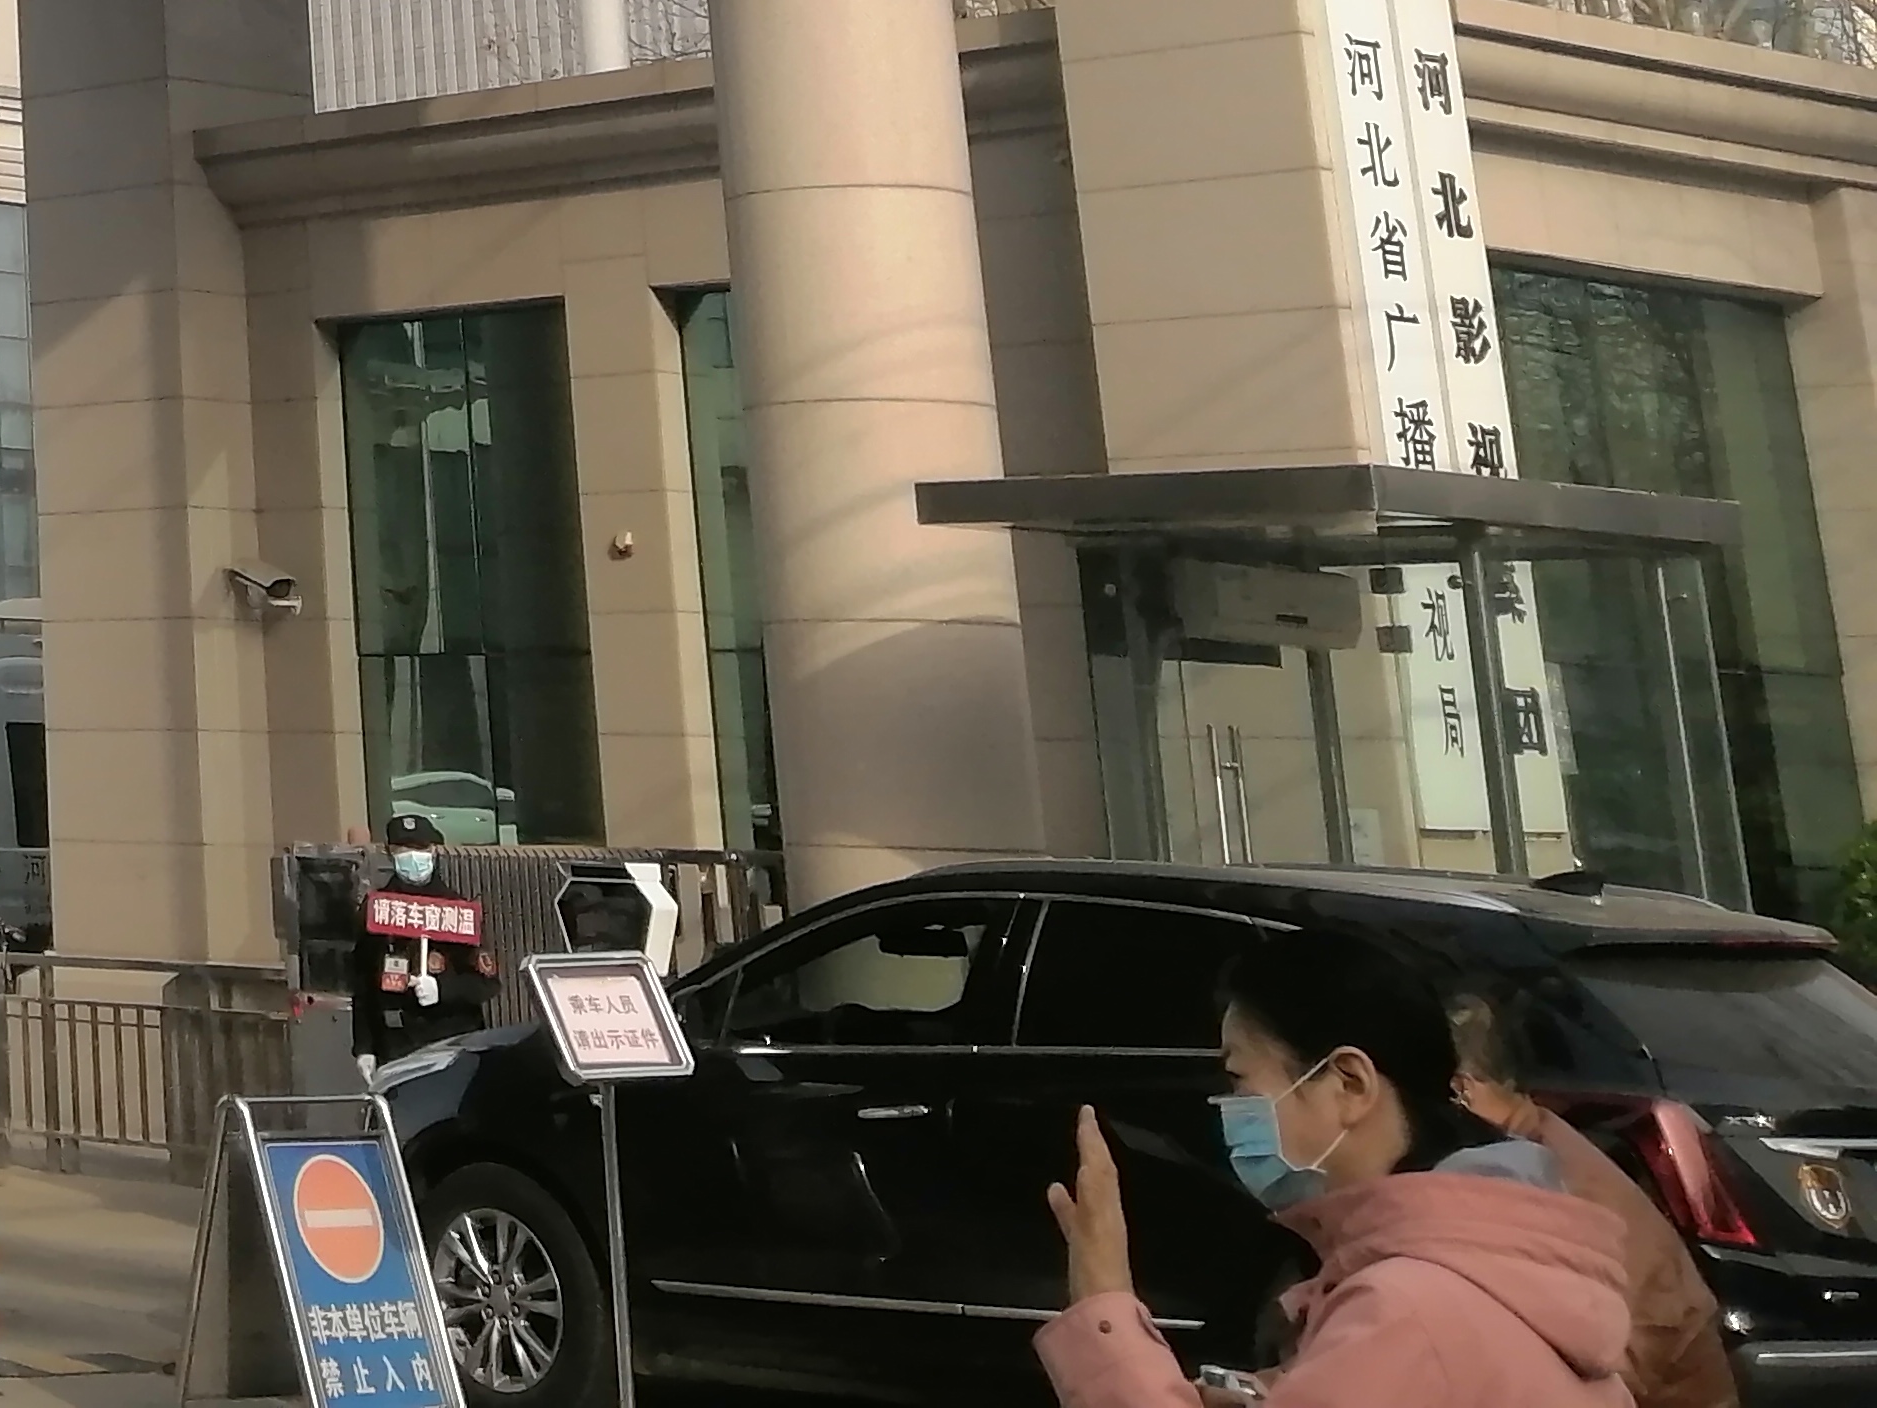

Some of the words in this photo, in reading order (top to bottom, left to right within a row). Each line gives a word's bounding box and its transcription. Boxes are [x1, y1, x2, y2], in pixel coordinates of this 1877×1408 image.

[373, 897, 475, 936] 请落车窗测温
[567, 994, 639, 1016] 乘车人员
[572, 1028, 660, 1051] 请出示证件
[307, 1300, 423, 1347] 非本单位车辆
[320, 1350, 435, 1400] 禁止入内
